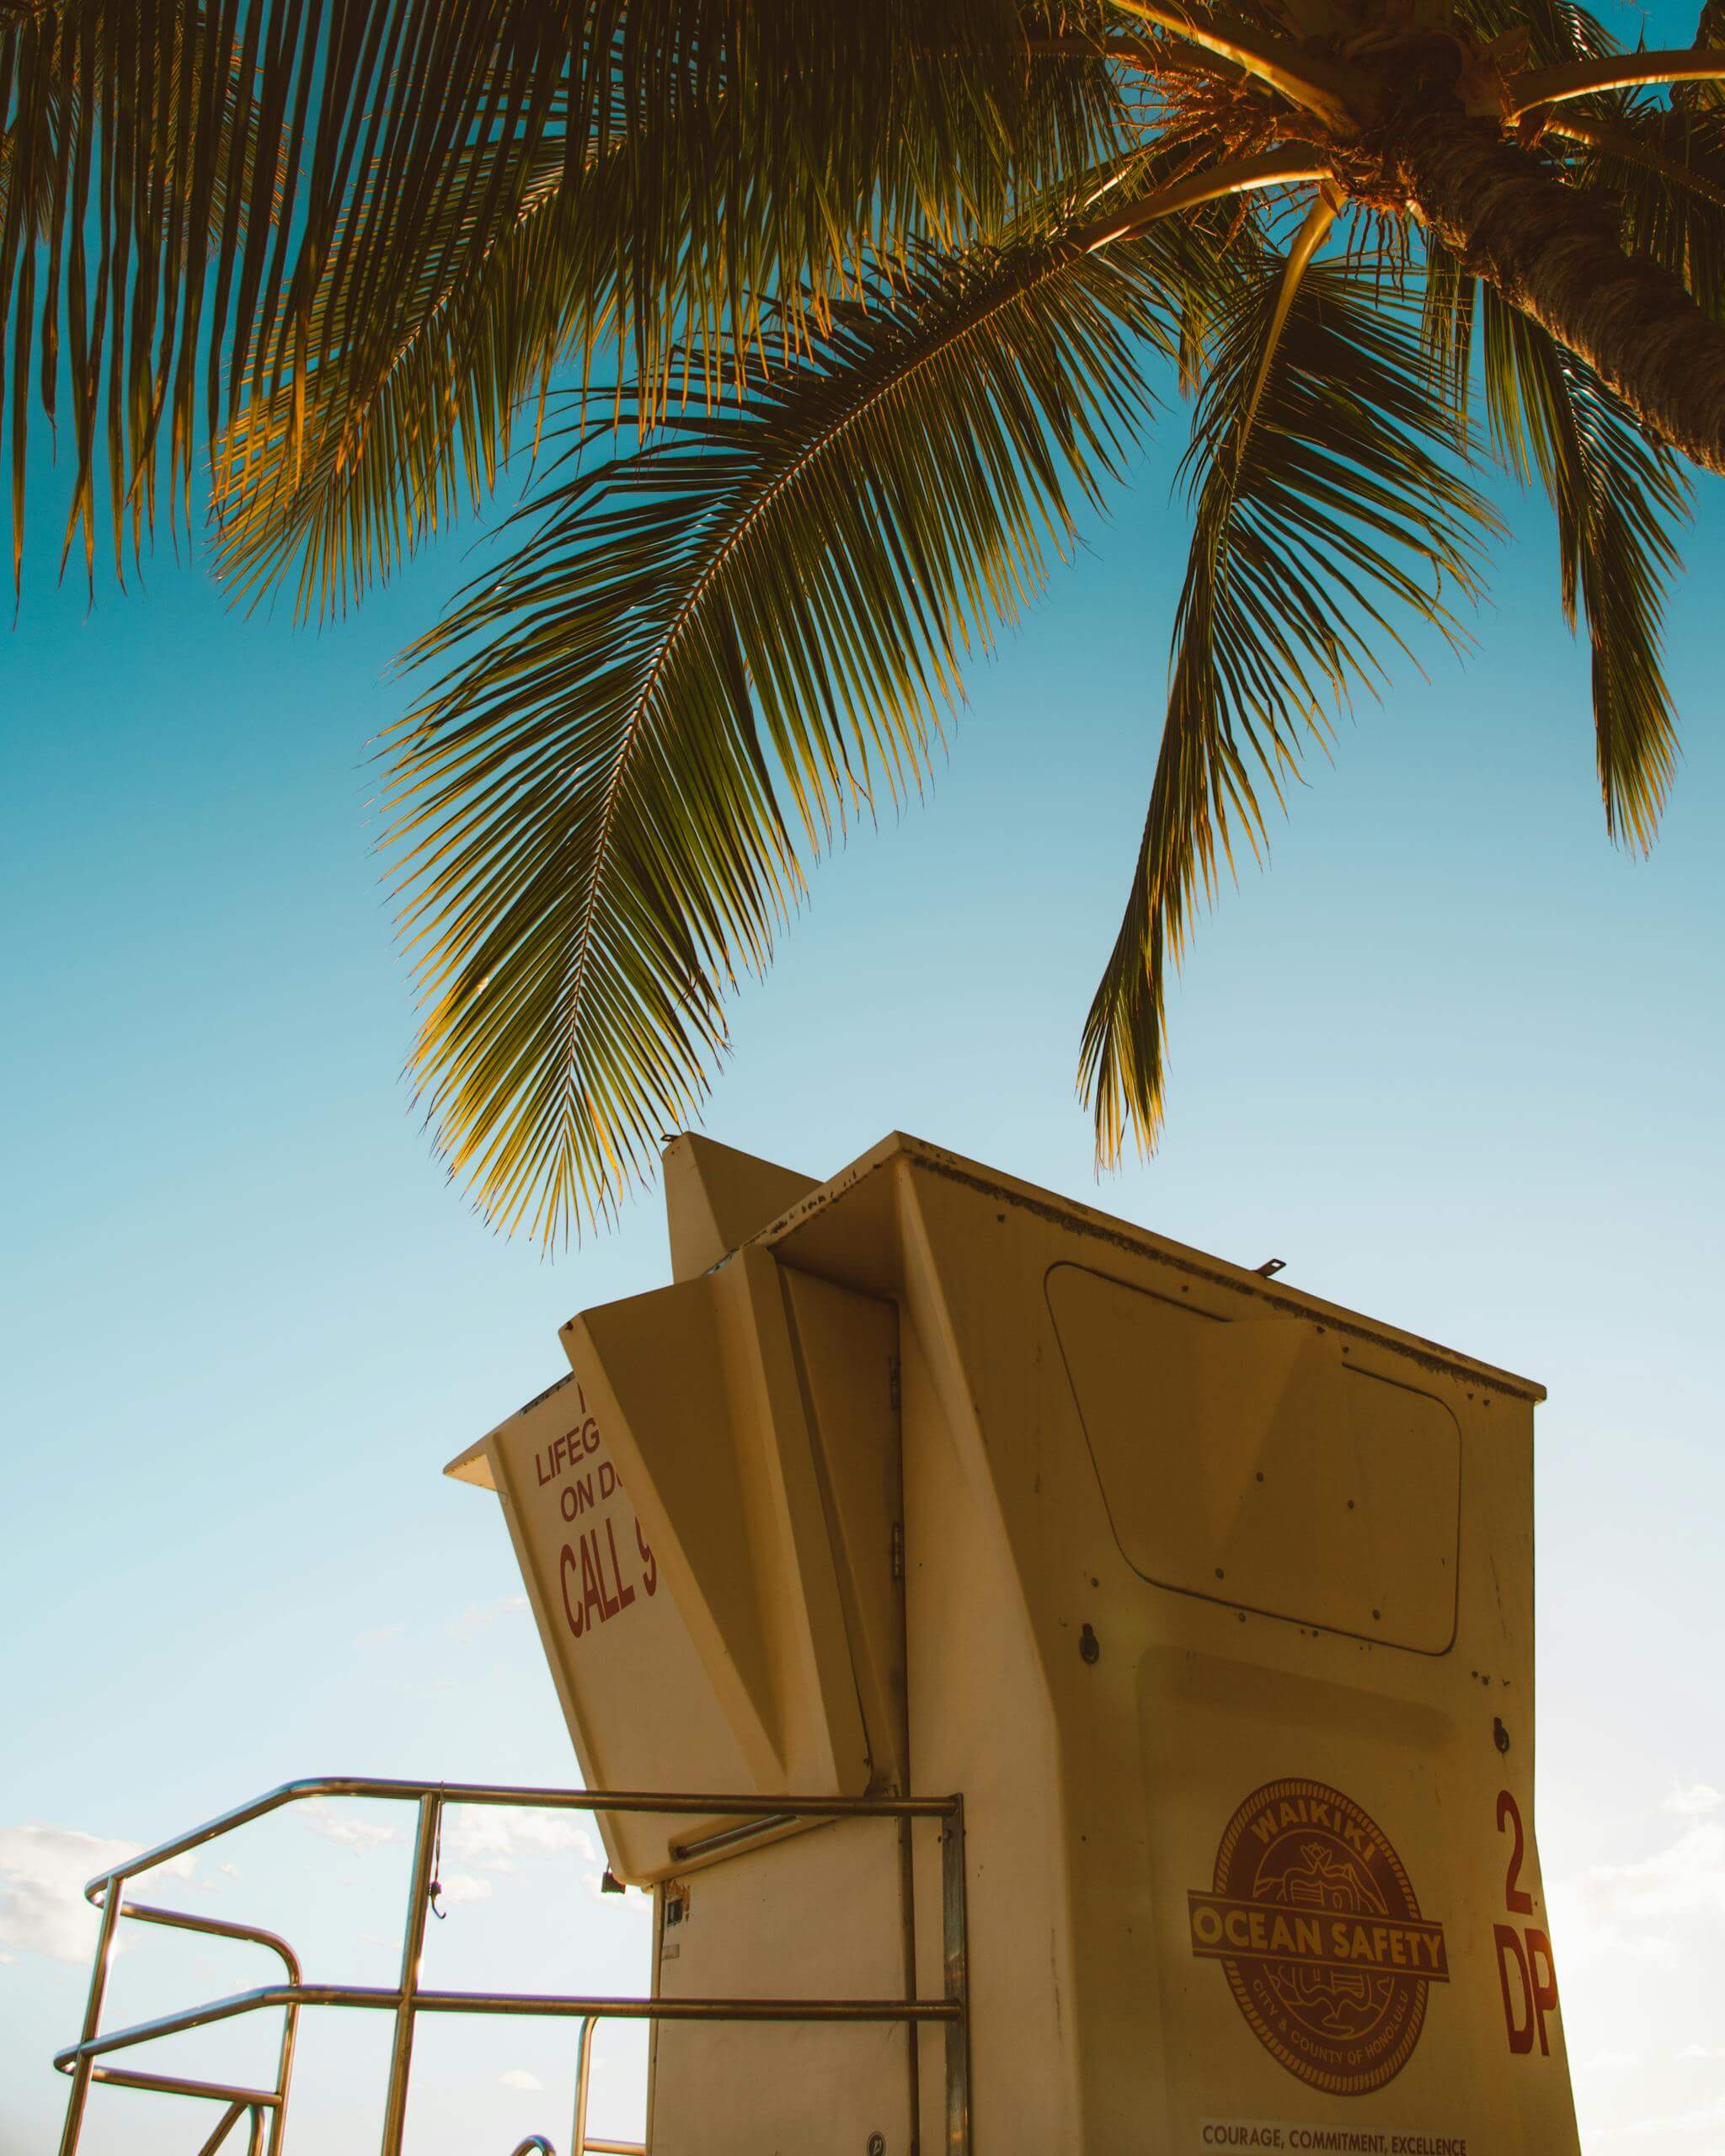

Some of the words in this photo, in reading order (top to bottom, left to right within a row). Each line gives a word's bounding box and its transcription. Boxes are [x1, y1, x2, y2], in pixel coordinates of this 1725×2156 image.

[560, 1473, 595, 1523] ON
[560, 1517, 636, 1639] CALL
[1251, 1799, 1375, 1862] WAIKIKI
[1496, 1790, 1533, 1915] 2
[1192, 1906, 1322, 1956] OCEAN
[1331, 1922, 1442, 1968] SAFETY
[1252, 1979, 1279, 2016] CITY
[1279, 2018, 1289, 2035] &
[1290, 2030, 1343, 2064] COUNTY
[1348, 2049, 1364, 2065] OF
[1365, 1989, 1409, 2060] HONOLULU
[1493, 1924, 1557, 2057] DP
[1202, 2125, 1285, 2150] COURAGE,
[1289, 2130, 1388, 2155] COMMITMENT,
[1391, 2135, 1467, 2156] EXCELLENCE
